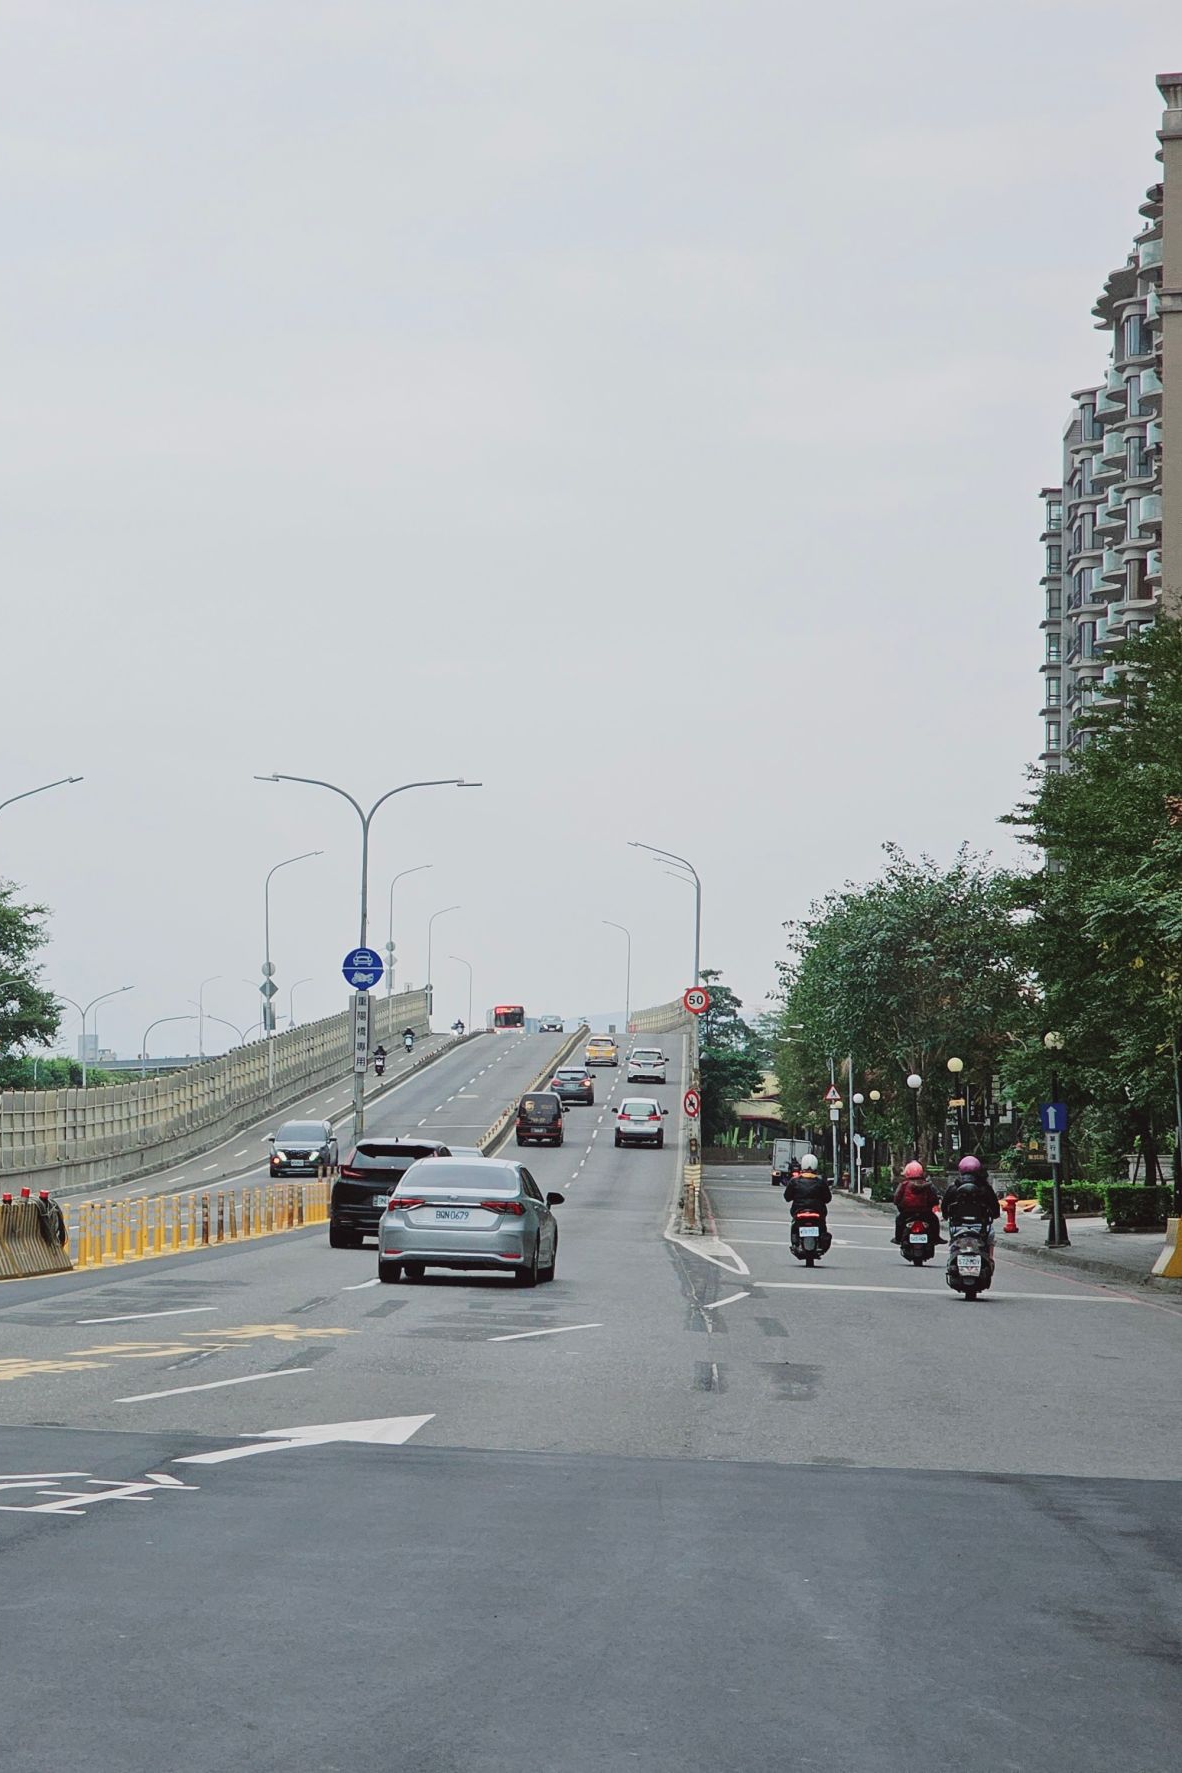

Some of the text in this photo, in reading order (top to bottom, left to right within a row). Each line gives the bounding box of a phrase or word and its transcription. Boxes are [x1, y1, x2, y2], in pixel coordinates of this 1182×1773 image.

[688, 995, 703, 1005] 50
[355, 996, 367, 1067] 重陽橋專用
